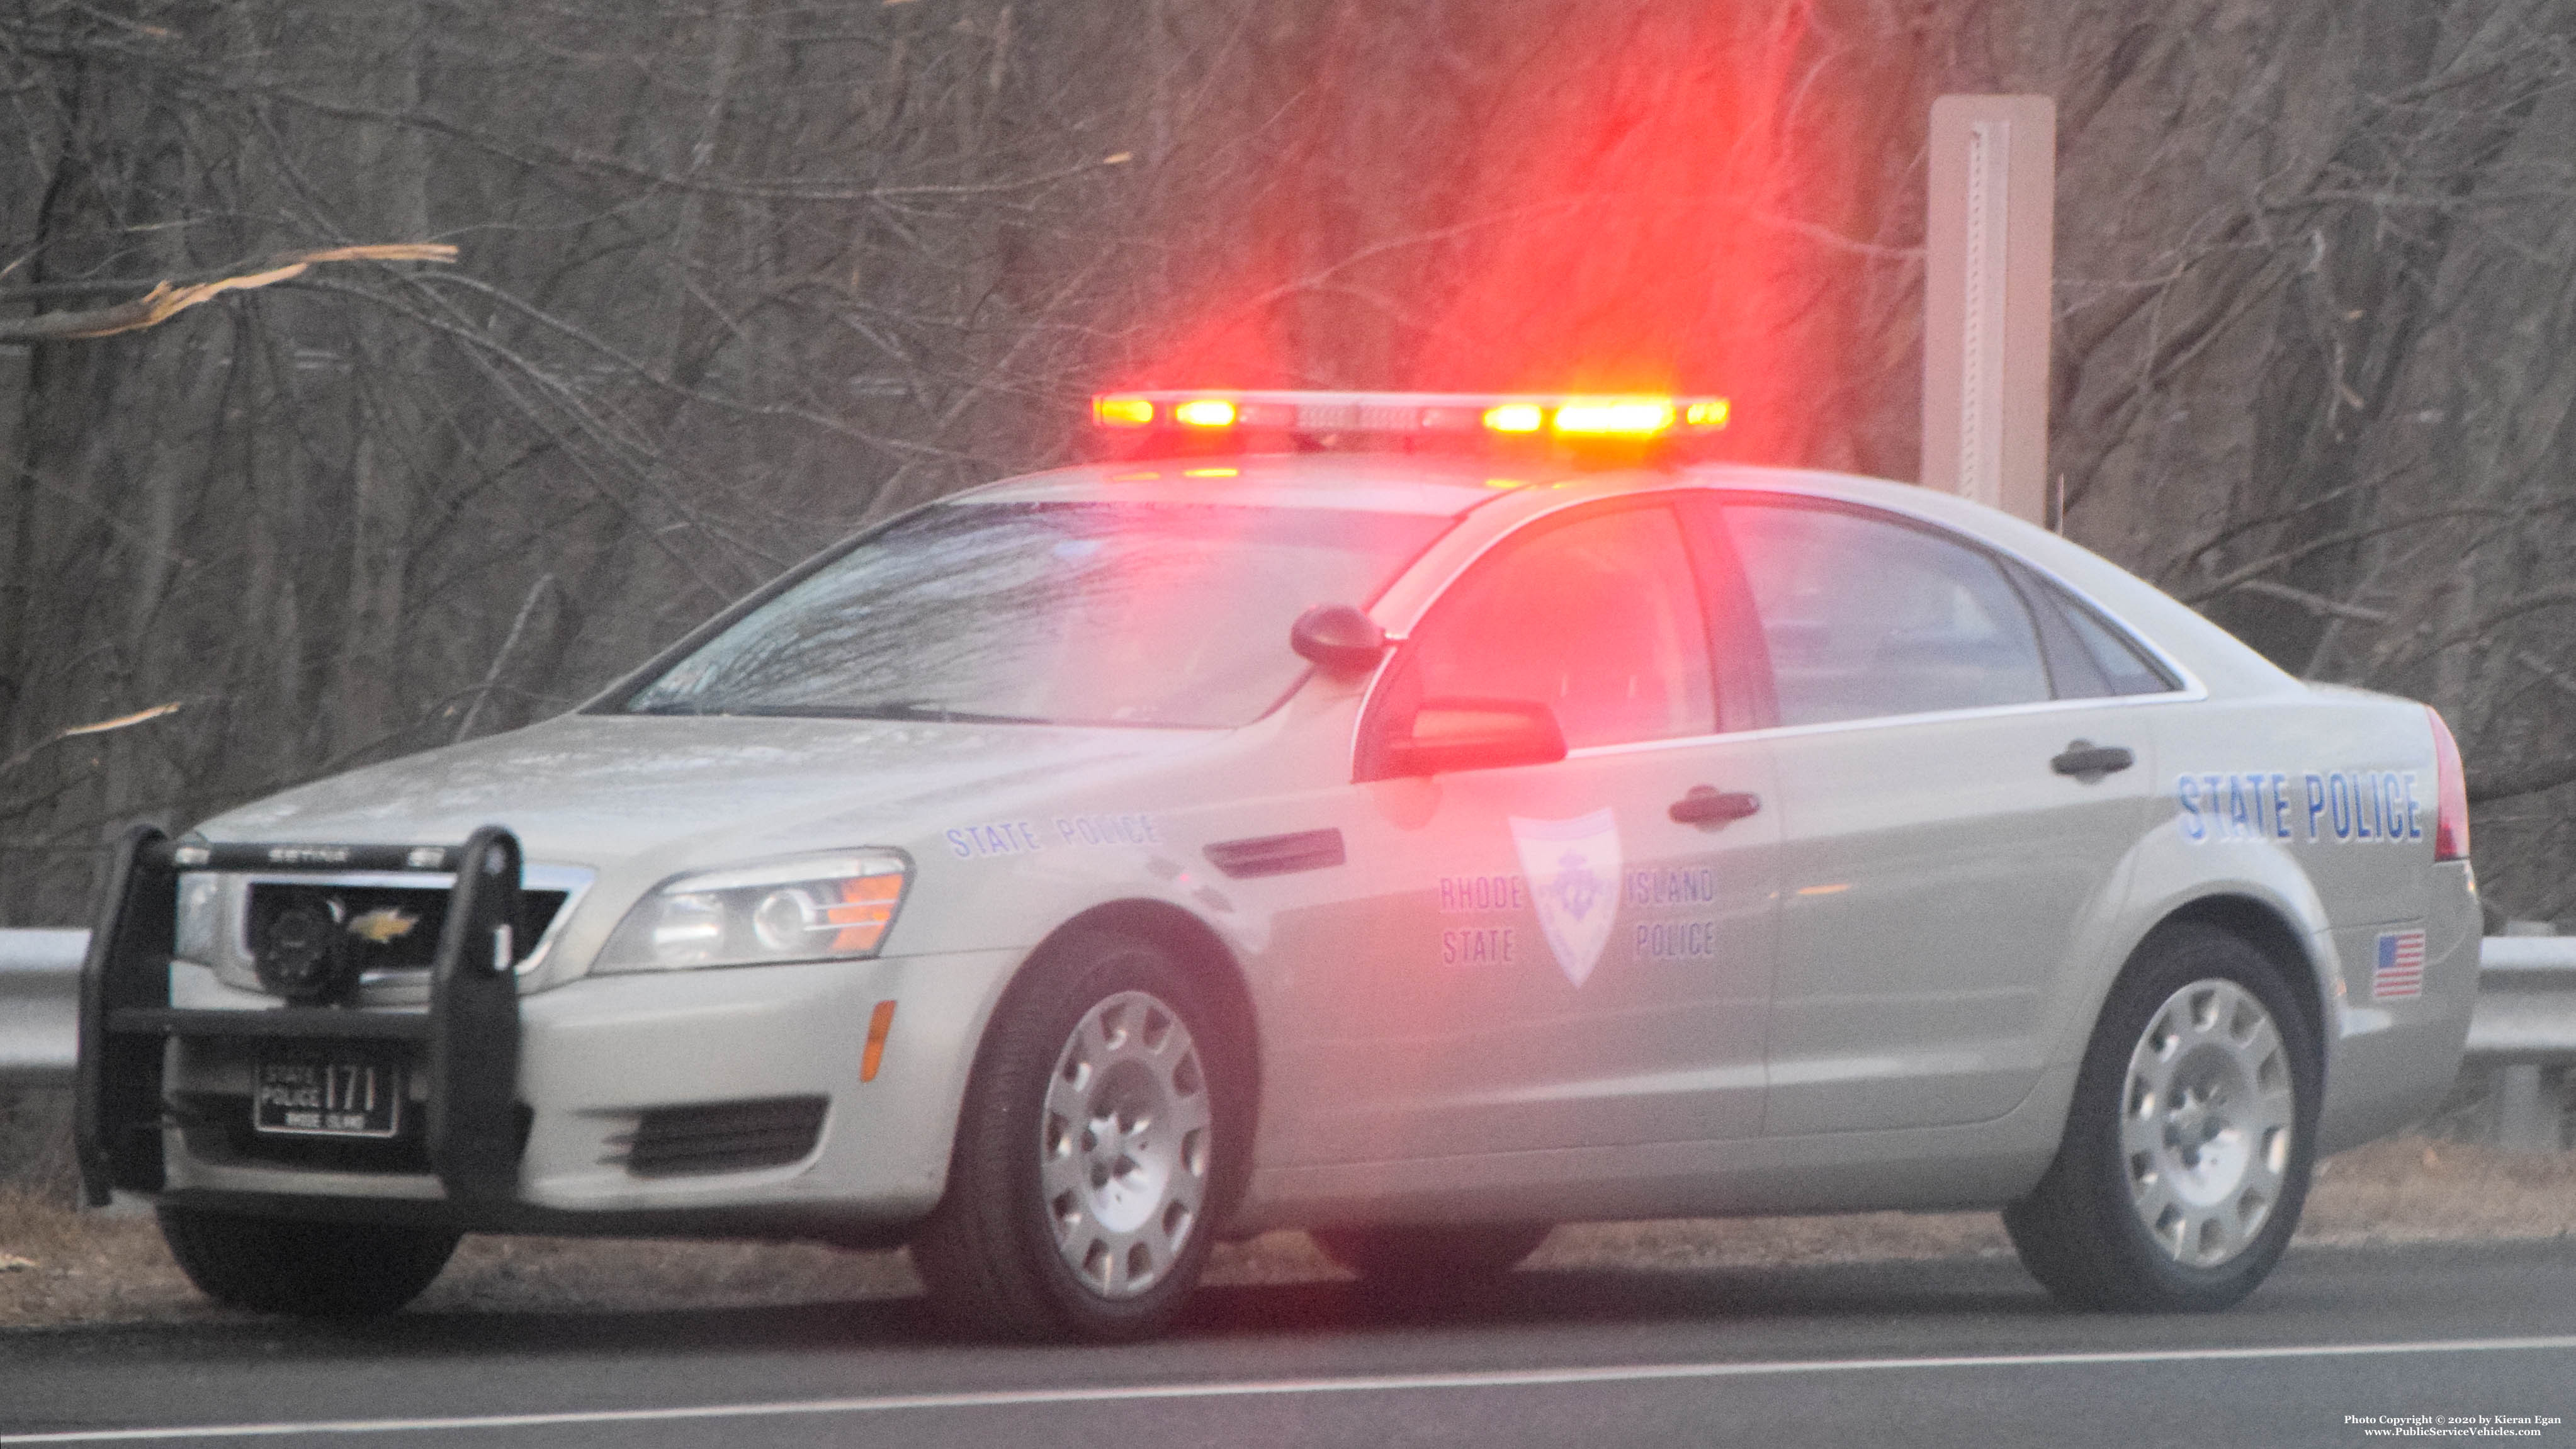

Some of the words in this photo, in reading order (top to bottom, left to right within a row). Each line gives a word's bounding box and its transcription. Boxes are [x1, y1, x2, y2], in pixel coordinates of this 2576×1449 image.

[2177, 773, 2289, 840] STATE
[2305, 773, 2421, 840] POLICE
[946, 822, 1040, 858] STATE
[1056, 815, 1161, 845] POLICE
[1440, 875, 1522, 910] RHODE
[1626, 869, 1714, 905] ISLAND
[1443, 929, 1514, 965] STATE
[1637, 922, 1714, 957] POLICE
[325, 1064, 376, 1111] 171
